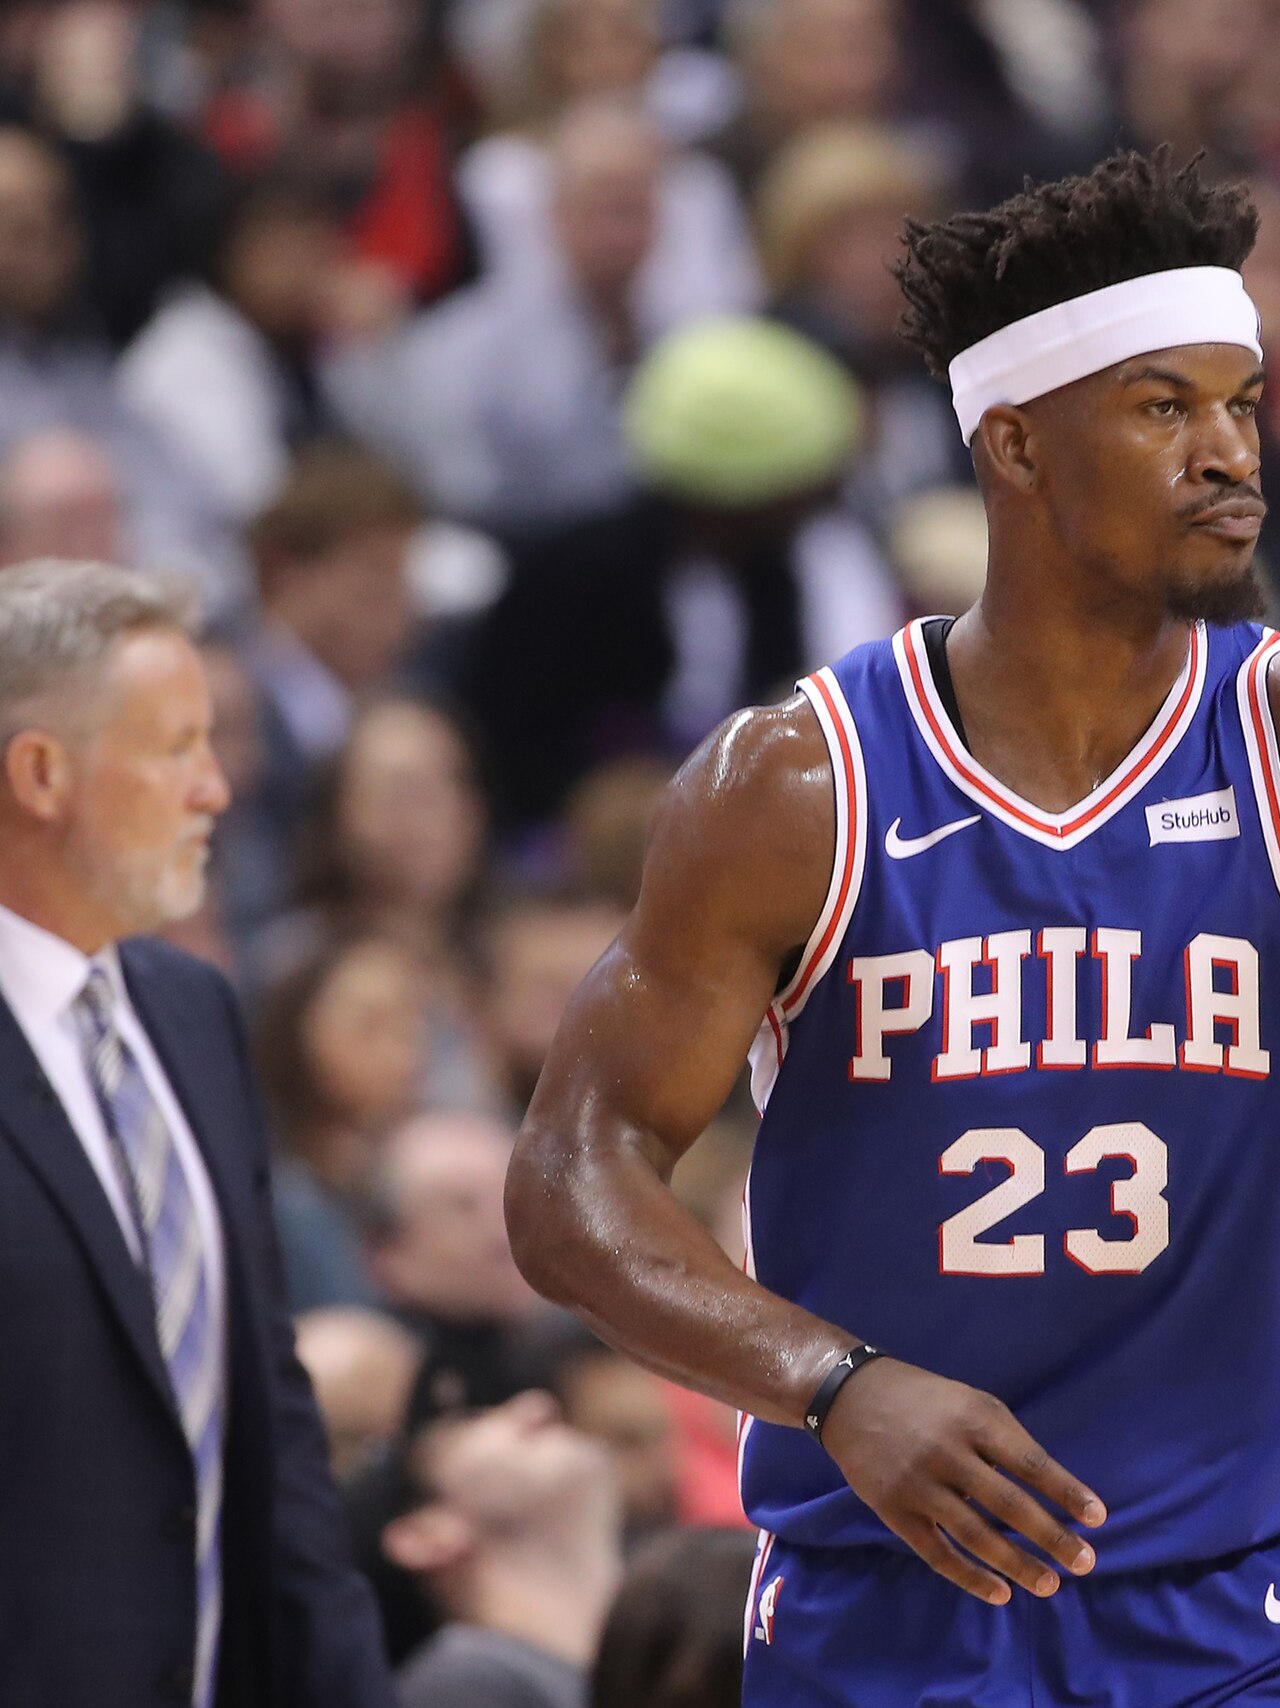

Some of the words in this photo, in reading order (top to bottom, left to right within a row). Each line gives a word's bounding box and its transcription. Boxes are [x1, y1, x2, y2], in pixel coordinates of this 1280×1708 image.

[1161, 806, 1231, 830] StubHub
[847, 926, 1271, 1082] PHILA
[938, 1121, 1170, 1277] 23
